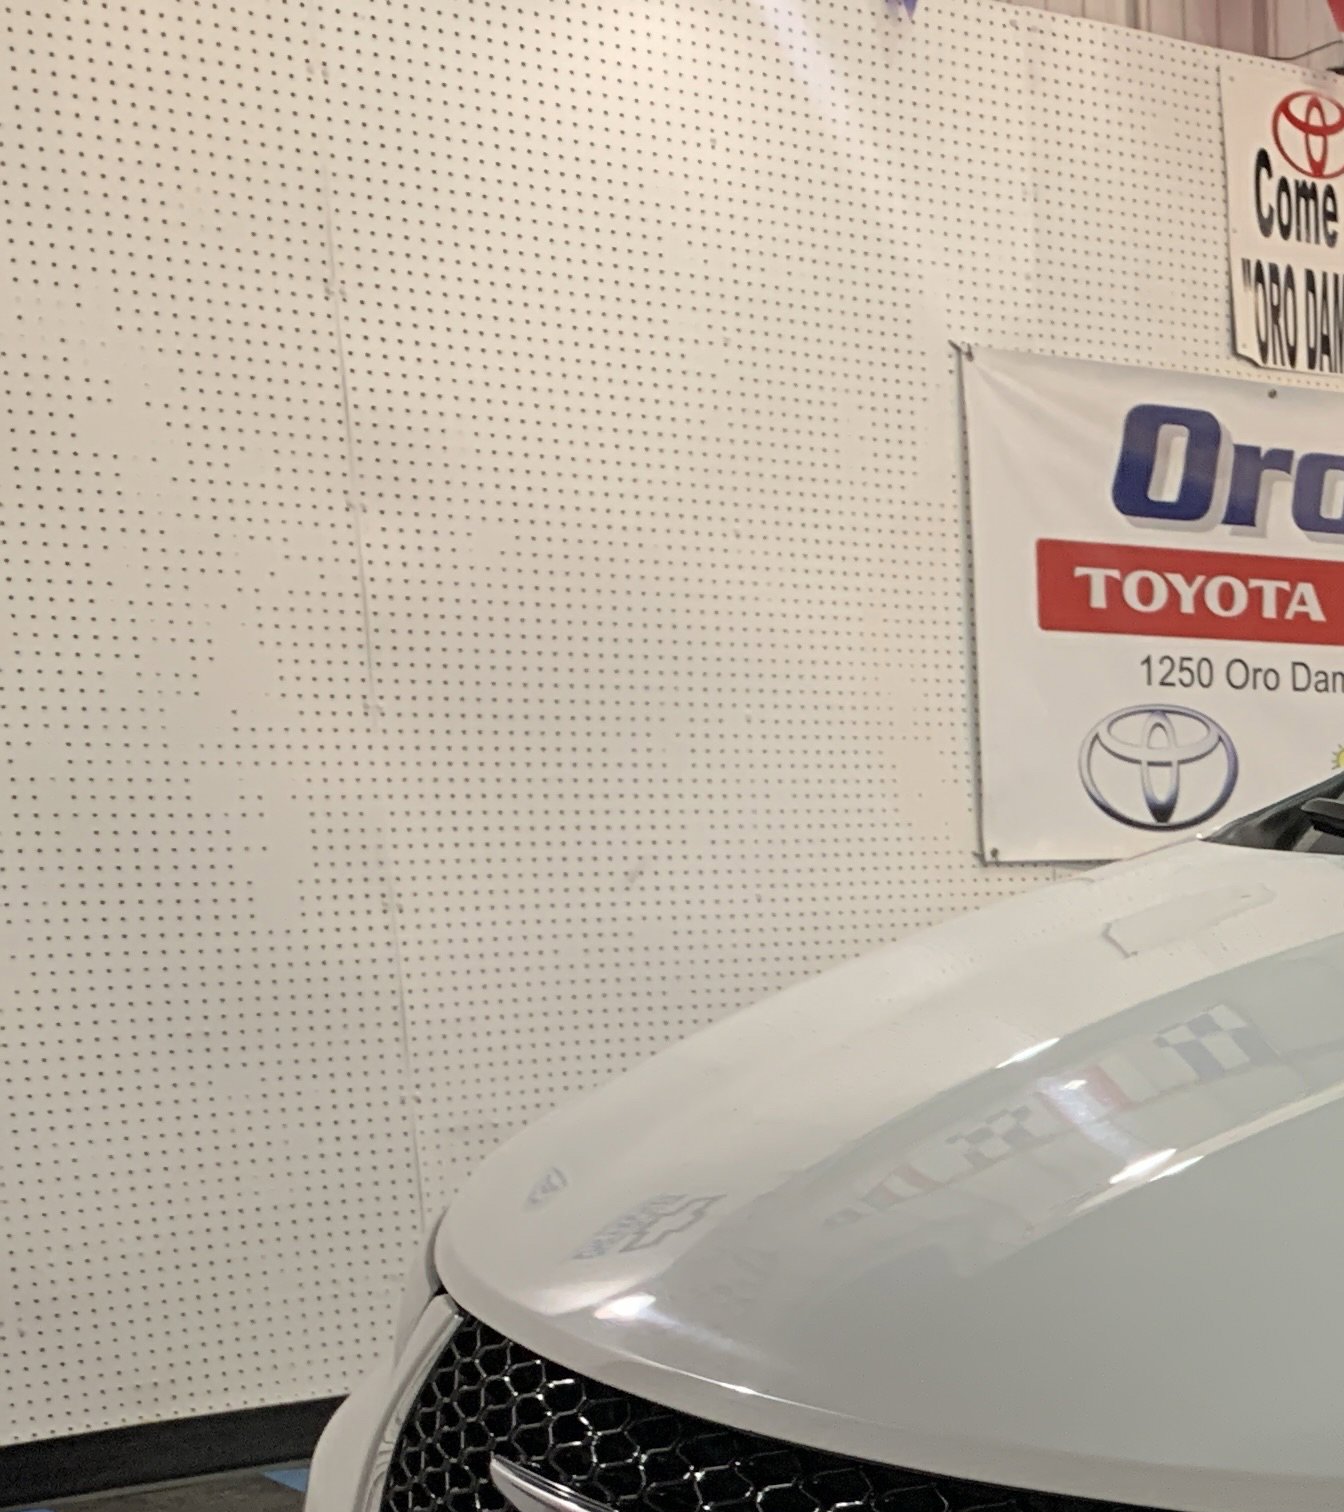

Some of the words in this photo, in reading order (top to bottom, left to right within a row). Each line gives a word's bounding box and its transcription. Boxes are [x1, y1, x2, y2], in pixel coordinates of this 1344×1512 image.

[1254, 148, 1338, 248] Come
[1073, 567, 1326, 622] TOYOTA
[1140, 655, 1213, 689] 1250
[1227, 659, 1280, 692] Oro
